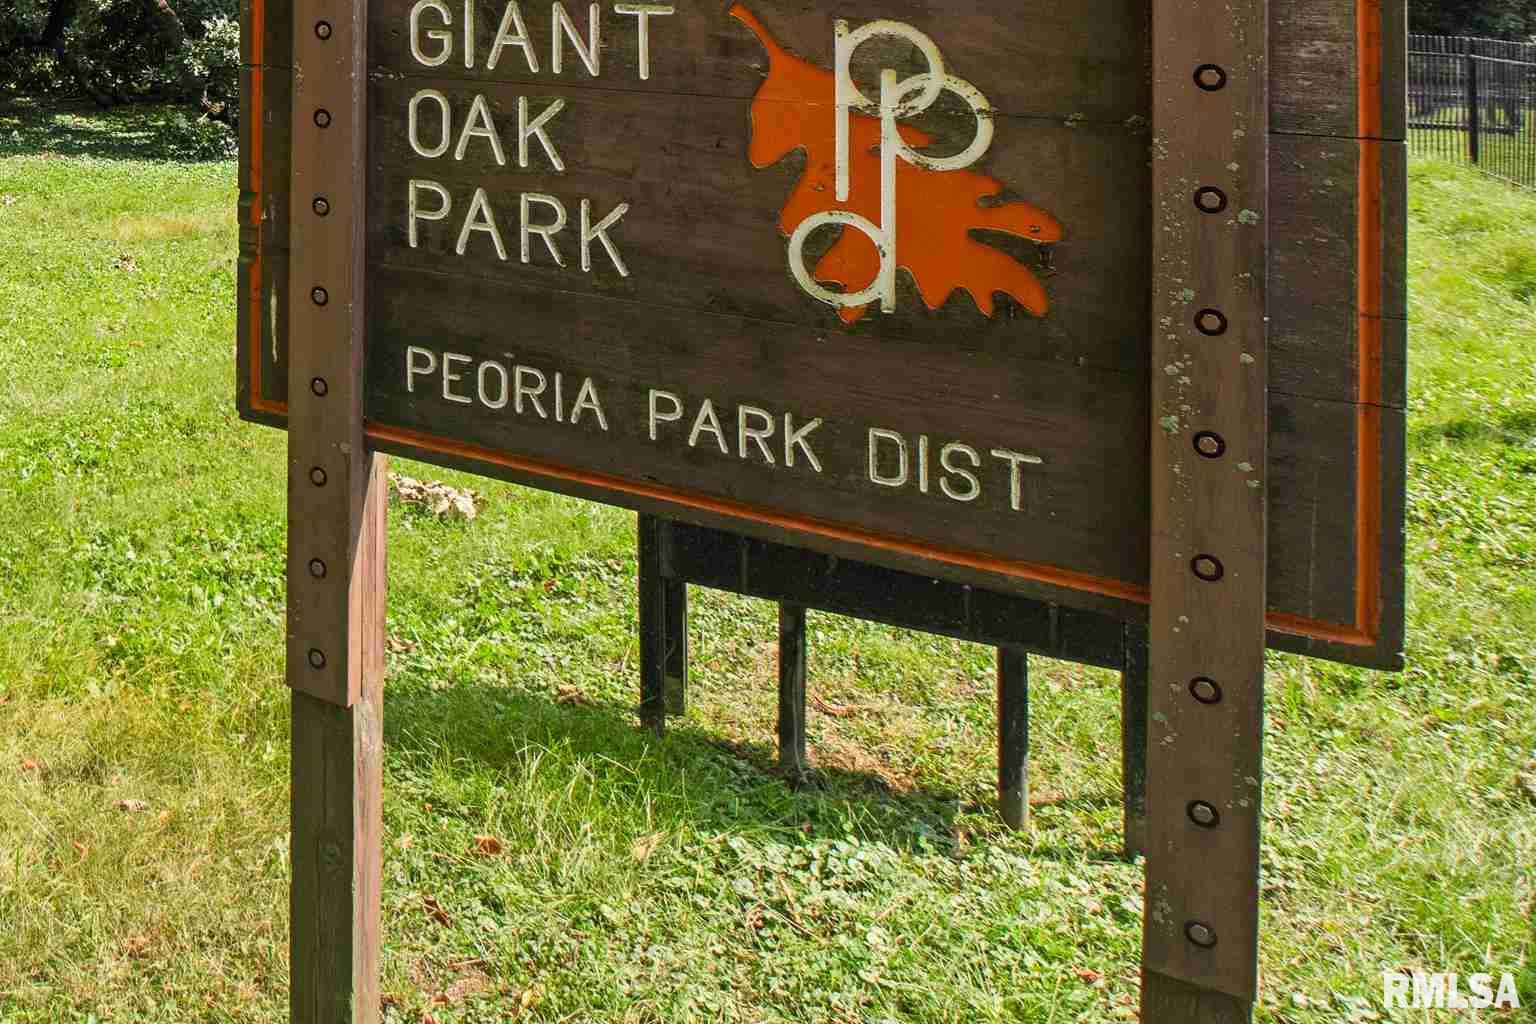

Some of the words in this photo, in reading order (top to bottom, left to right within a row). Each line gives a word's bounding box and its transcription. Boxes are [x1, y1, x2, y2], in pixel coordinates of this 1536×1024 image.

[408, 88, 565, 171] OAK
[408, 178, 631, 277] PARK
[406, 345, 609, 431] PEORIA
[648, 388, 825, 473] PARK
[867, 426, 1043, 511] DIST
